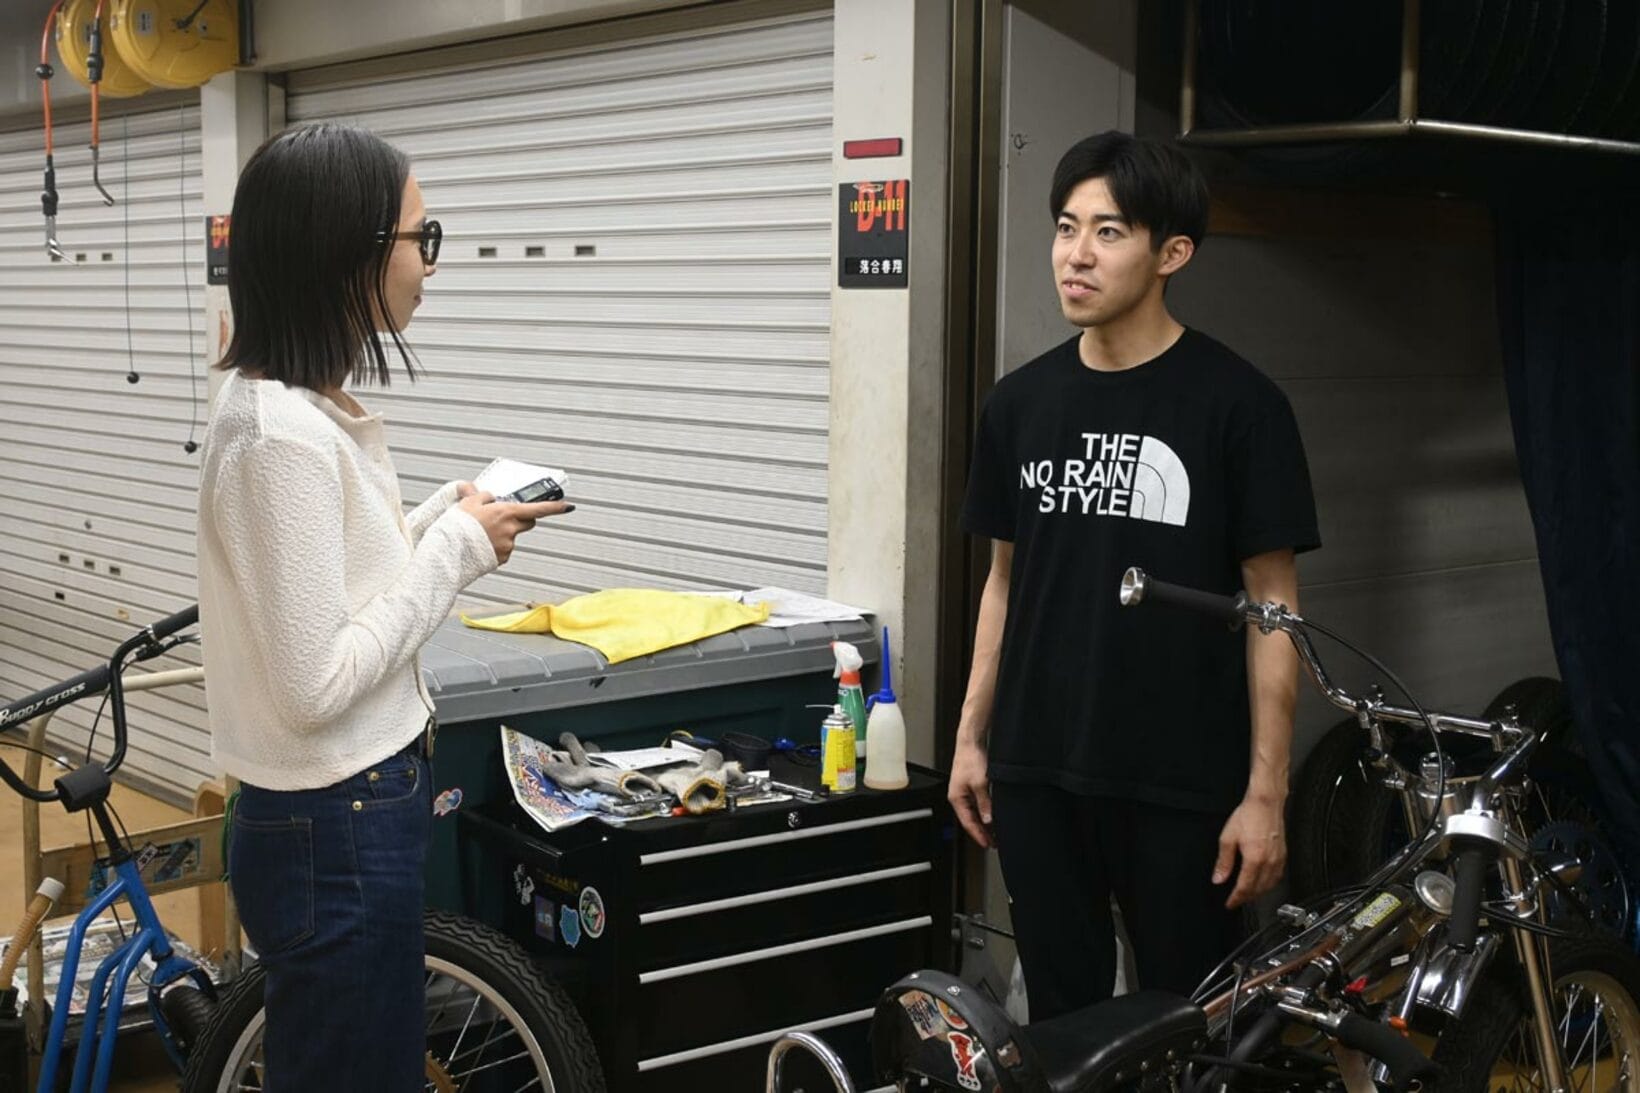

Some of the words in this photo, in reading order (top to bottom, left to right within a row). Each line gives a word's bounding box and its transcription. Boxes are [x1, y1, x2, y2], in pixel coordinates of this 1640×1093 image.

[1081, 432, 1140, 462] THE
[1020, 459, 1053, 490] NO
[1063, 459, 1134, 490] RAIN
[1038, 486, 1130, 517] STYLE
